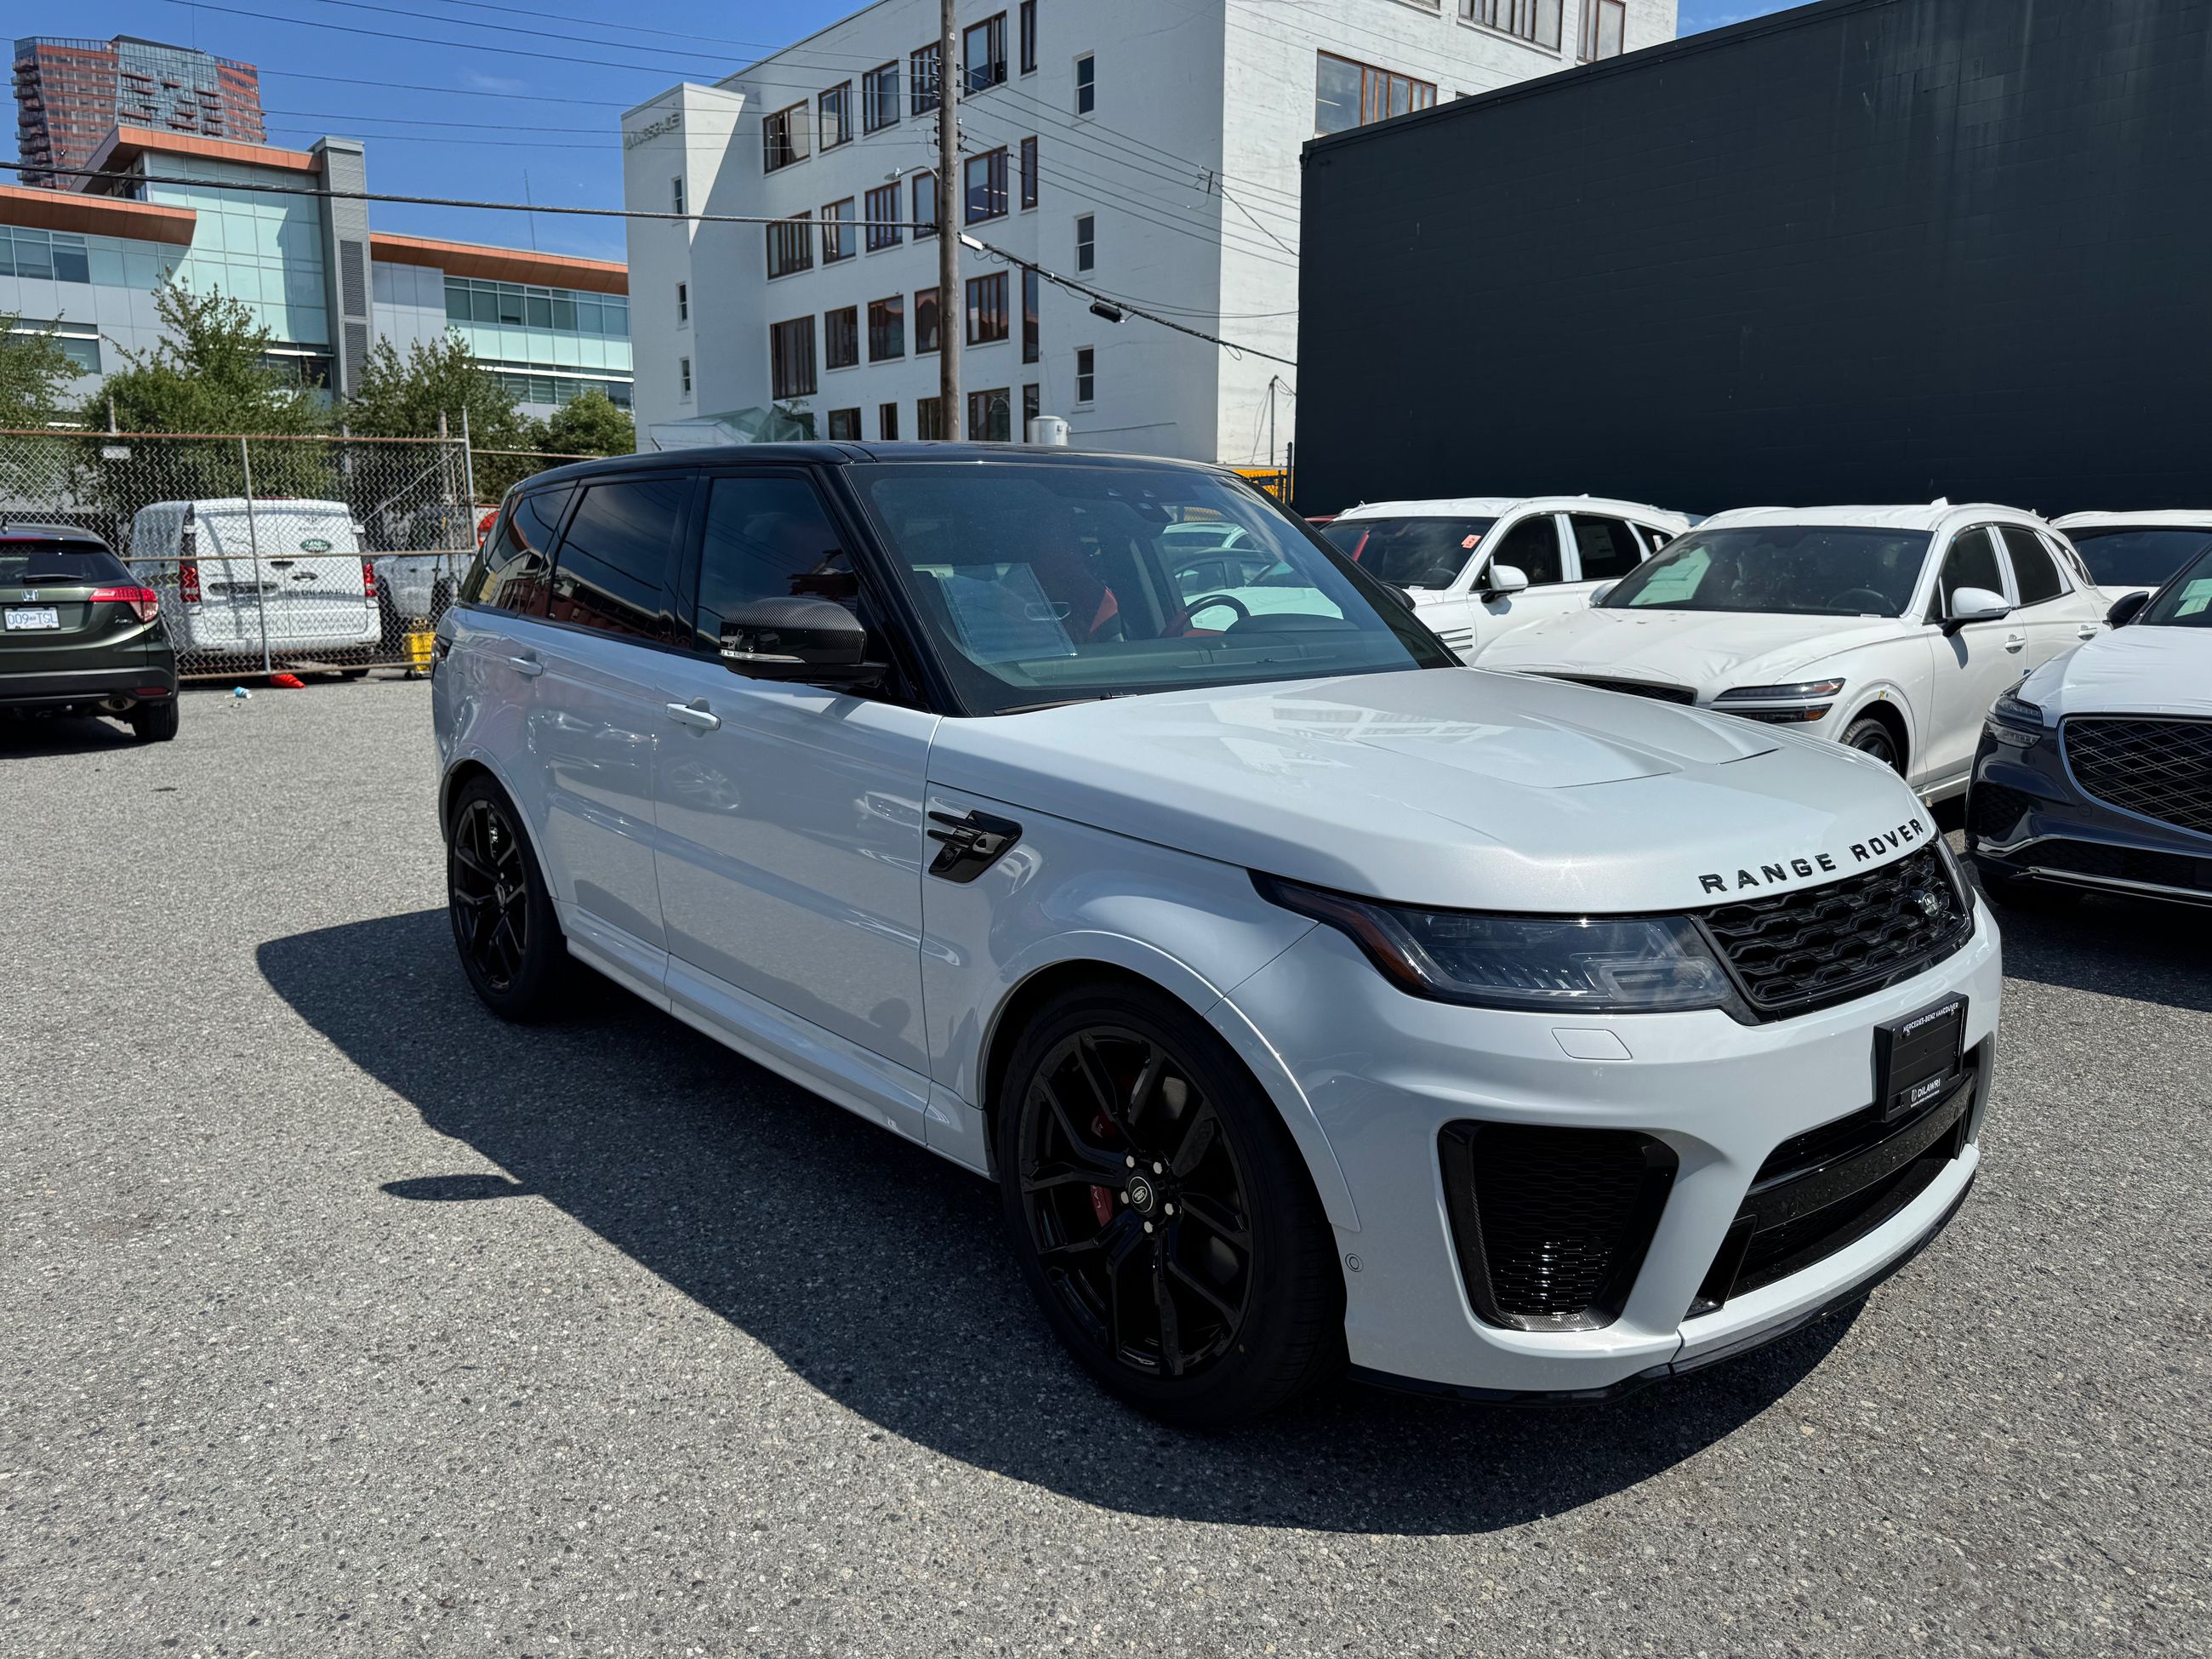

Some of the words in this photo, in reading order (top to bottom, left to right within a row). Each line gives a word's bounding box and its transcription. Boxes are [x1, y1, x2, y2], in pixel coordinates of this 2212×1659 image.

[7, 613, 29, 625] 009
[36, 613, 58, 624] TSL
[1698, 853, 1837, 894] RANGE
[1849, 818, 1924, 863] ROVER
[1902, 1012, 1936, 1033] MERCEDES-BENZ
[1936, 1002, 1959, 1018] VANCOUVER
[1917, 1078, 1941, 1098] DILAWRI
